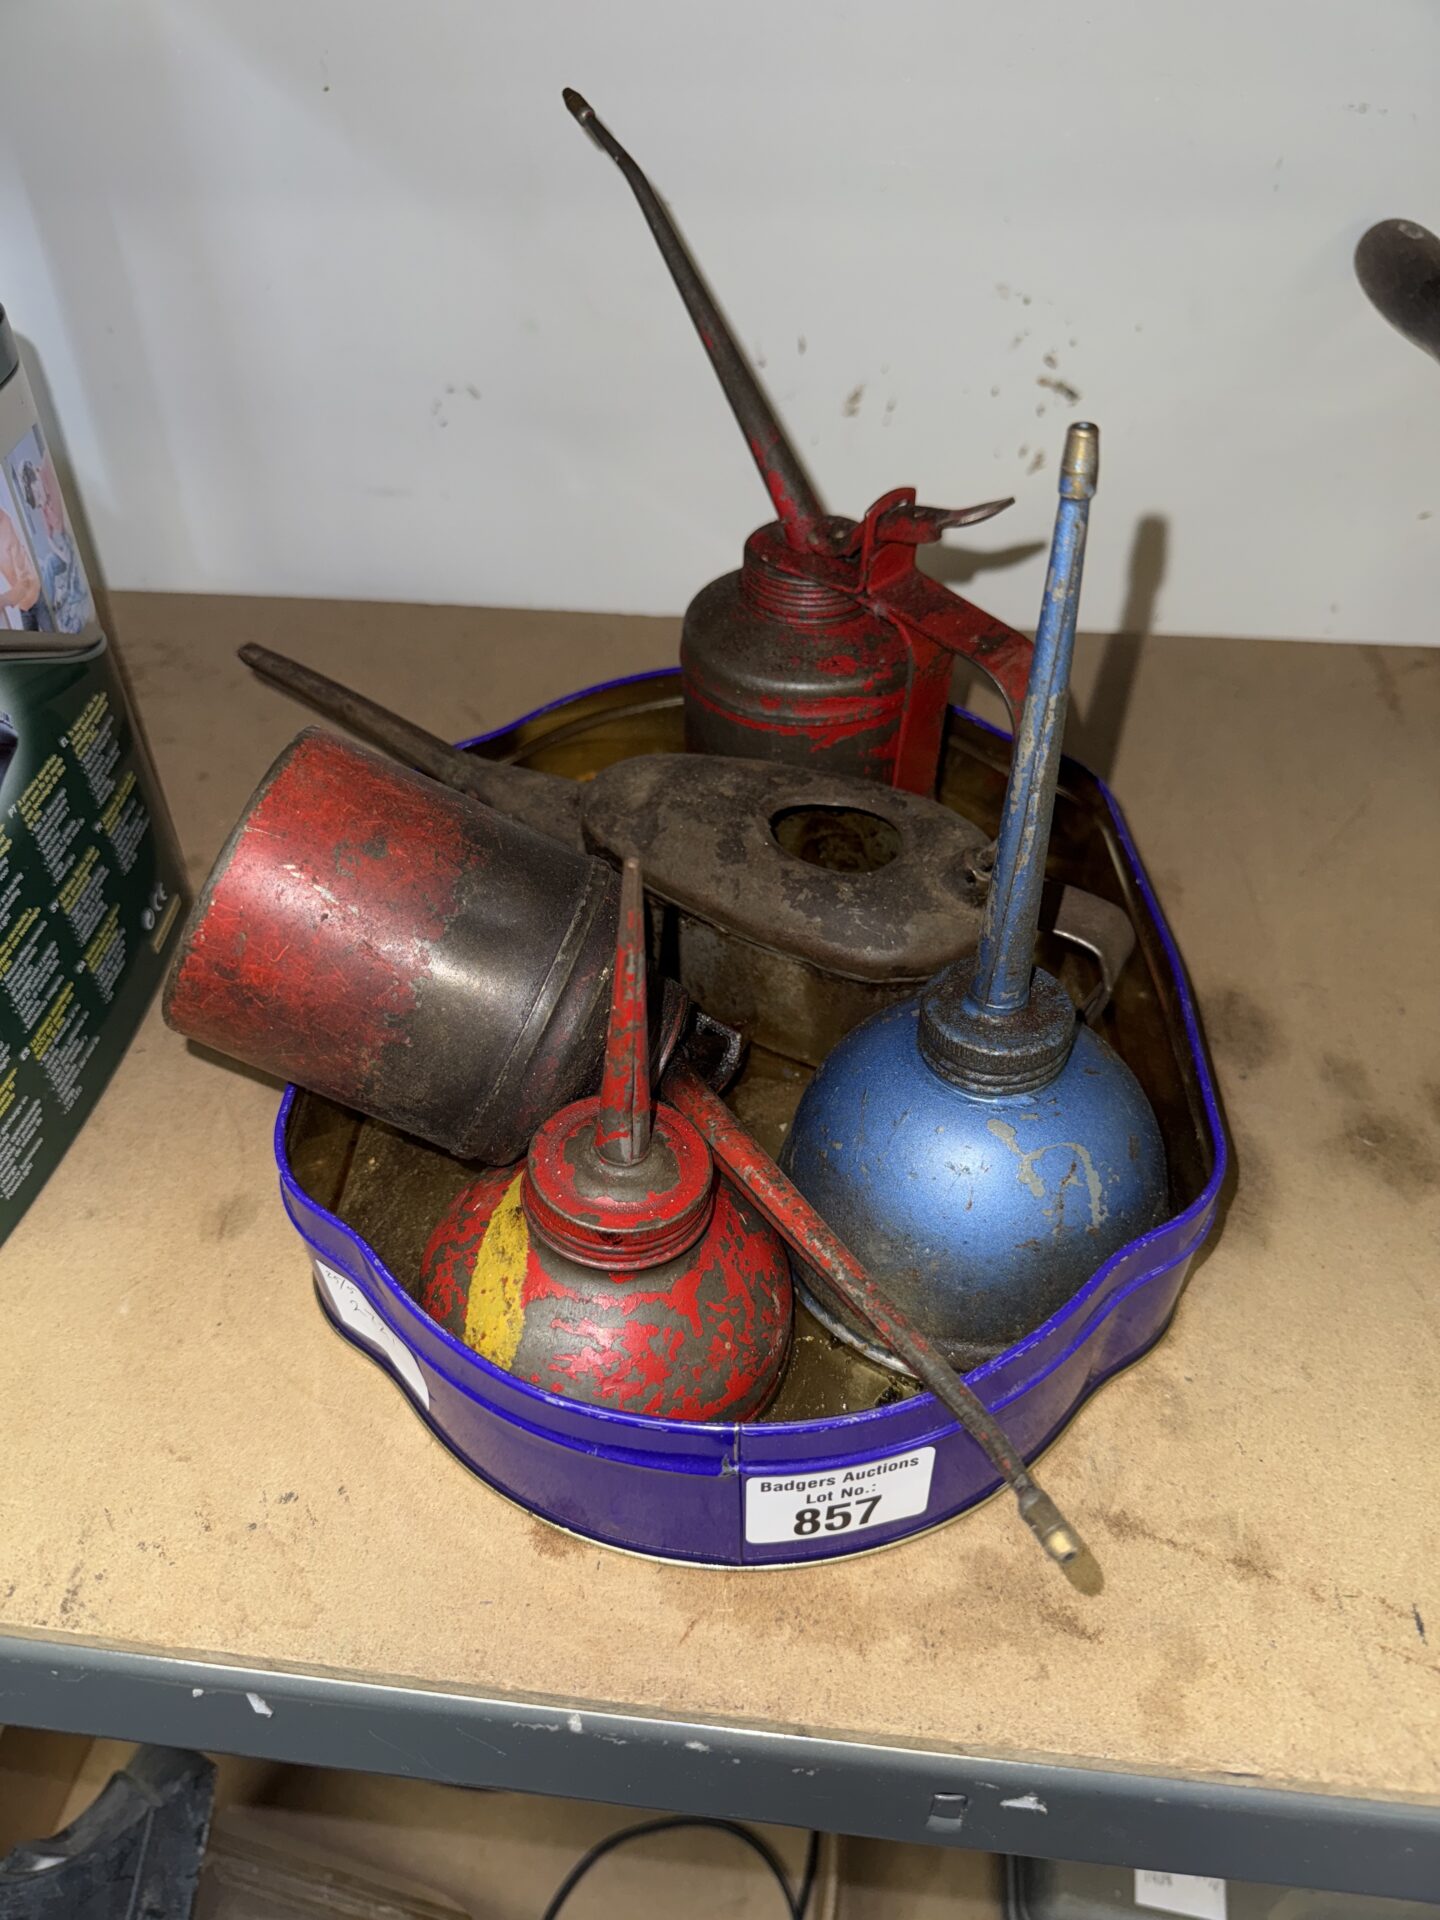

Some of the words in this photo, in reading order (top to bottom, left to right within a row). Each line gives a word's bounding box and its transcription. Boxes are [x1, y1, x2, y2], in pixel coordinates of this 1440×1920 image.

[760, 1476, 836, 1493] Badgers
[842, 1456, 920, 1483] Auctions
[805, 1491, 833, 1504] Lot
[840, 1483, 877, 1499] No.:
[793, 1494, 883, 1536] 857
